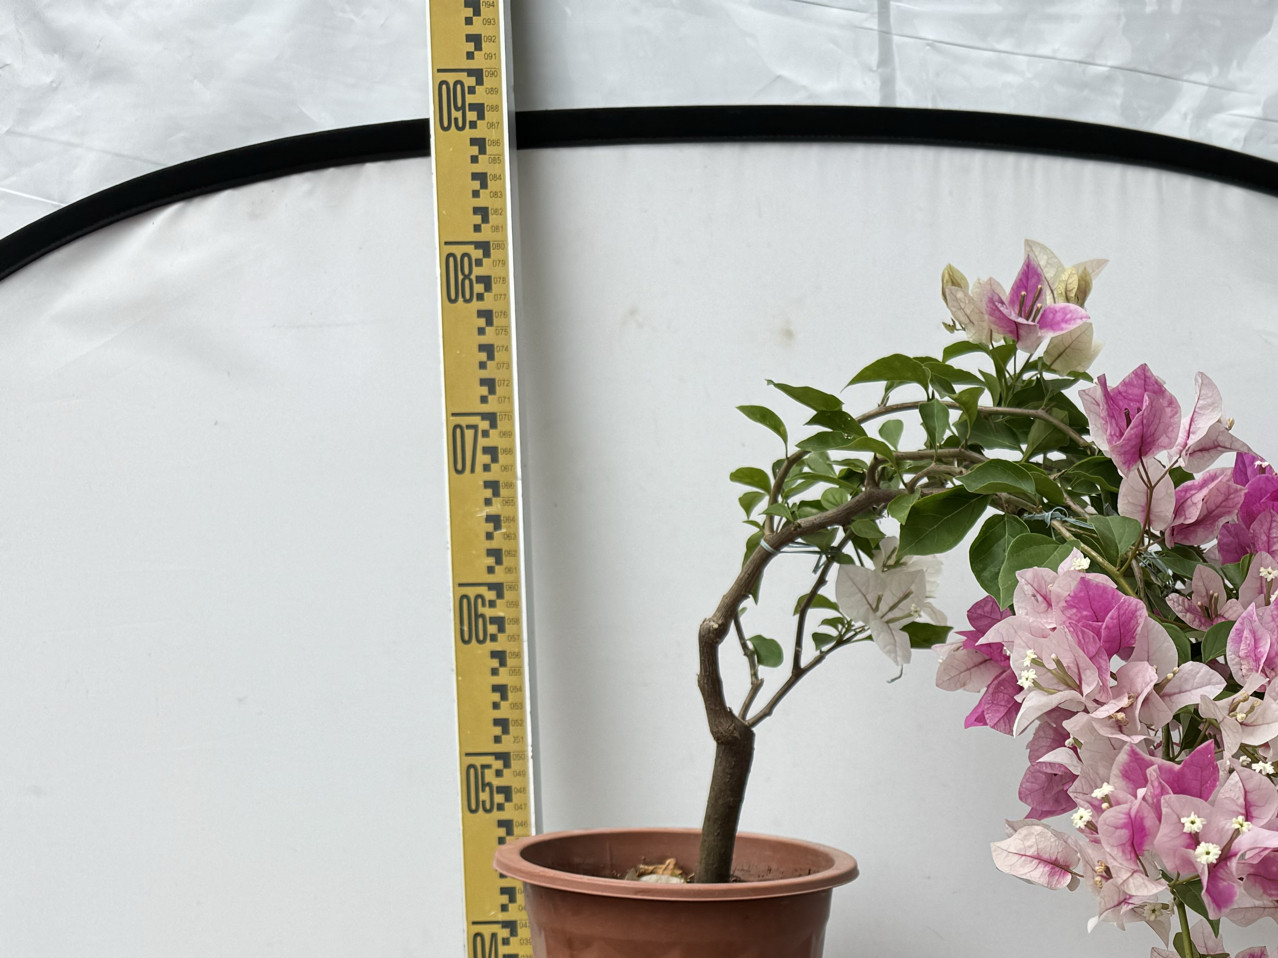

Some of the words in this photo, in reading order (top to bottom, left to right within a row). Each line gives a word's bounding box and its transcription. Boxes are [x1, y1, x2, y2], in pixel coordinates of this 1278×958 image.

[438, 80, 466, 132] 09
[446, 253, 474, 304] 08
[452, 424, 479, 474] 07
[459, 594, 488, 645] 06
[466, 764, 494, 814] 05
